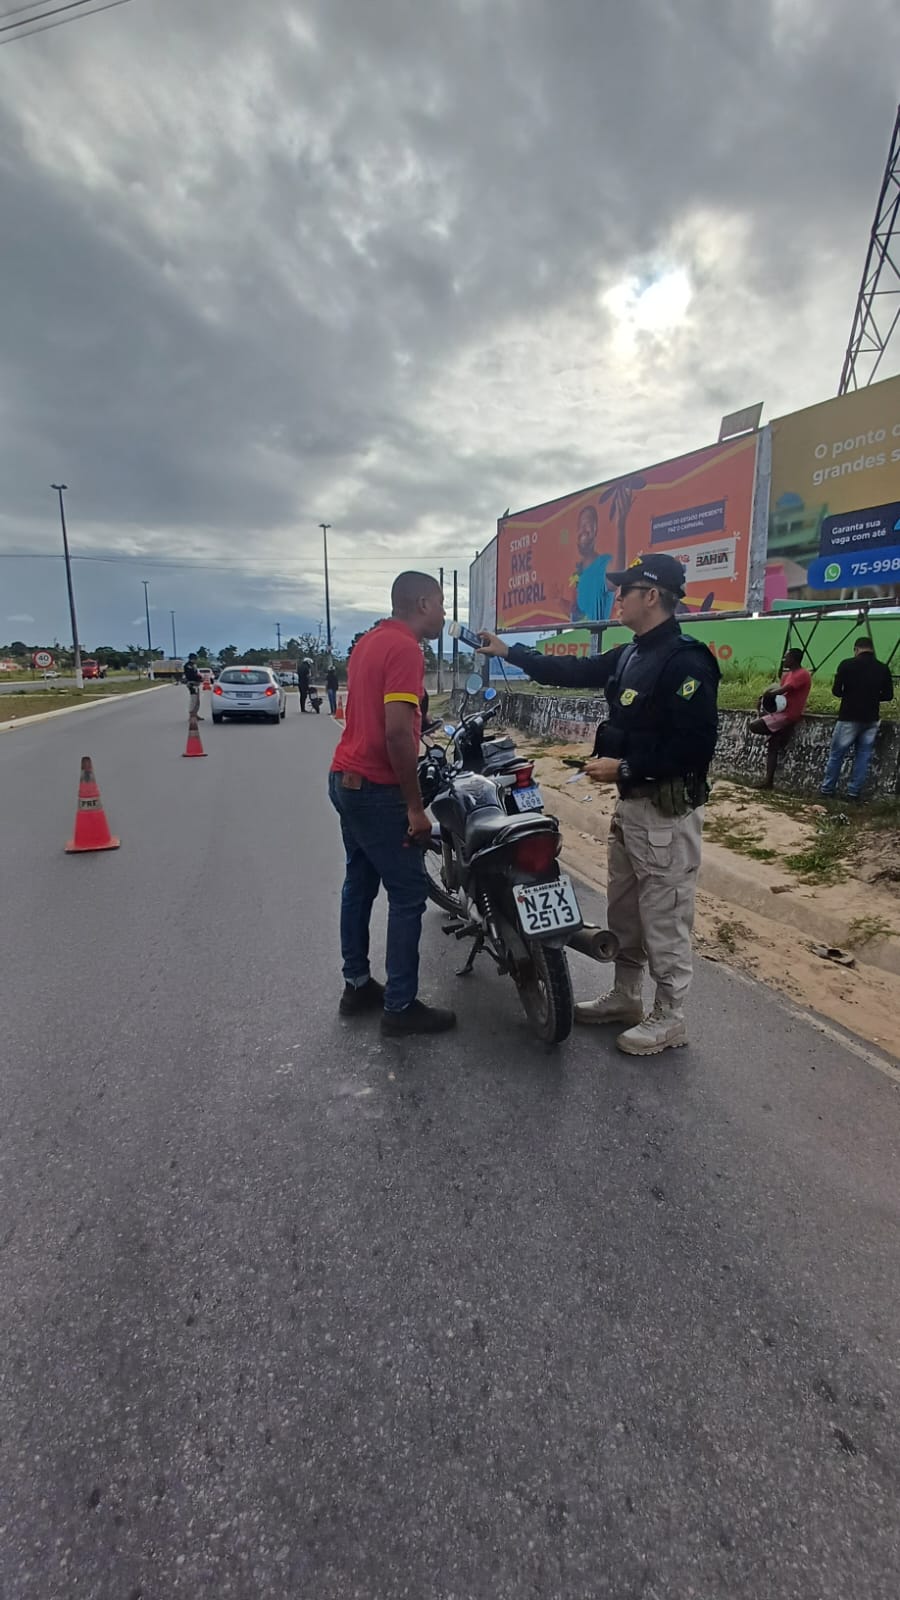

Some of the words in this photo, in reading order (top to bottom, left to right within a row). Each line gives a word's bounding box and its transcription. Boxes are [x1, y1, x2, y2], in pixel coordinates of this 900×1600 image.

[814, 443, 829, 459] O
[831, 428, 886, 458] ponto
[812, 451, 886, 486] grandes
[831, 523, 864, 535] Garanta
[865, 520, 881, 529] sua
[831, 536, 851, 545] vaga
[851, 532, 871, 542] com
[871, 527, 887, 538] até
[531, 532, 538, 544] O
[695, 552, 728, 568] BAHIA
[851, 557, 900, 576] 75-998
[531, 570, 537, 582] O
[502, 583, 546, 610] LITORAL
[524, 887, 569, 914] NZX
[526, 905, 575, 931] 2513
